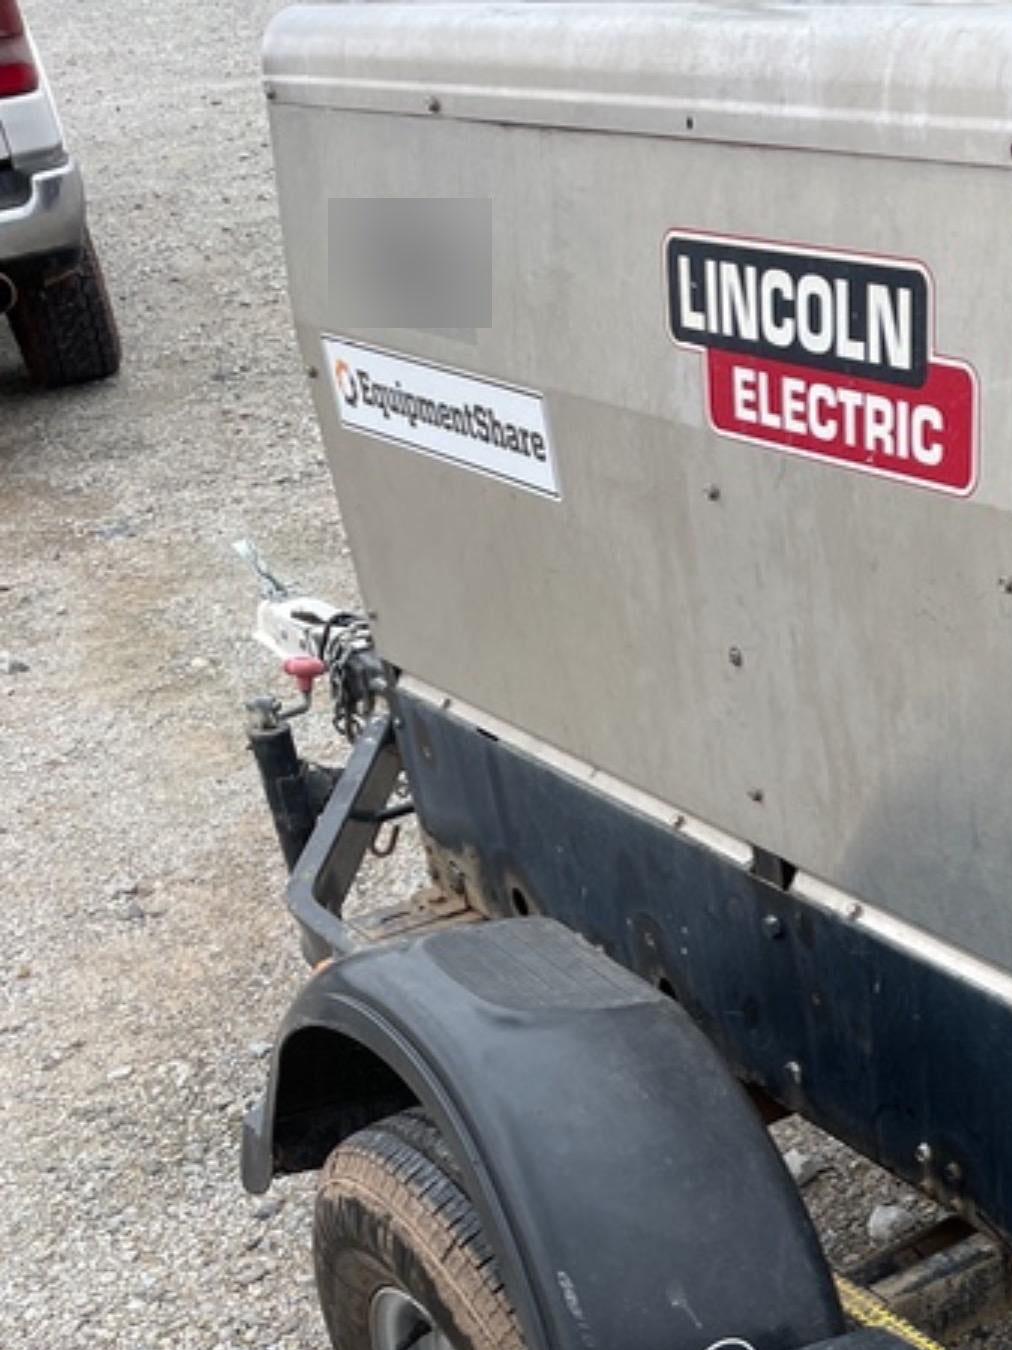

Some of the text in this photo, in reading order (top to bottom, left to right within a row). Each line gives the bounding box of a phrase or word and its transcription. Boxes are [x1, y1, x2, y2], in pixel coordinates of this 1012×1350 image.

[677, 254, 913, 371] LINCOLN
[356, 368, 547, 462] EquipmentShare
[732, 365, 945, 467] ELECTRIC
